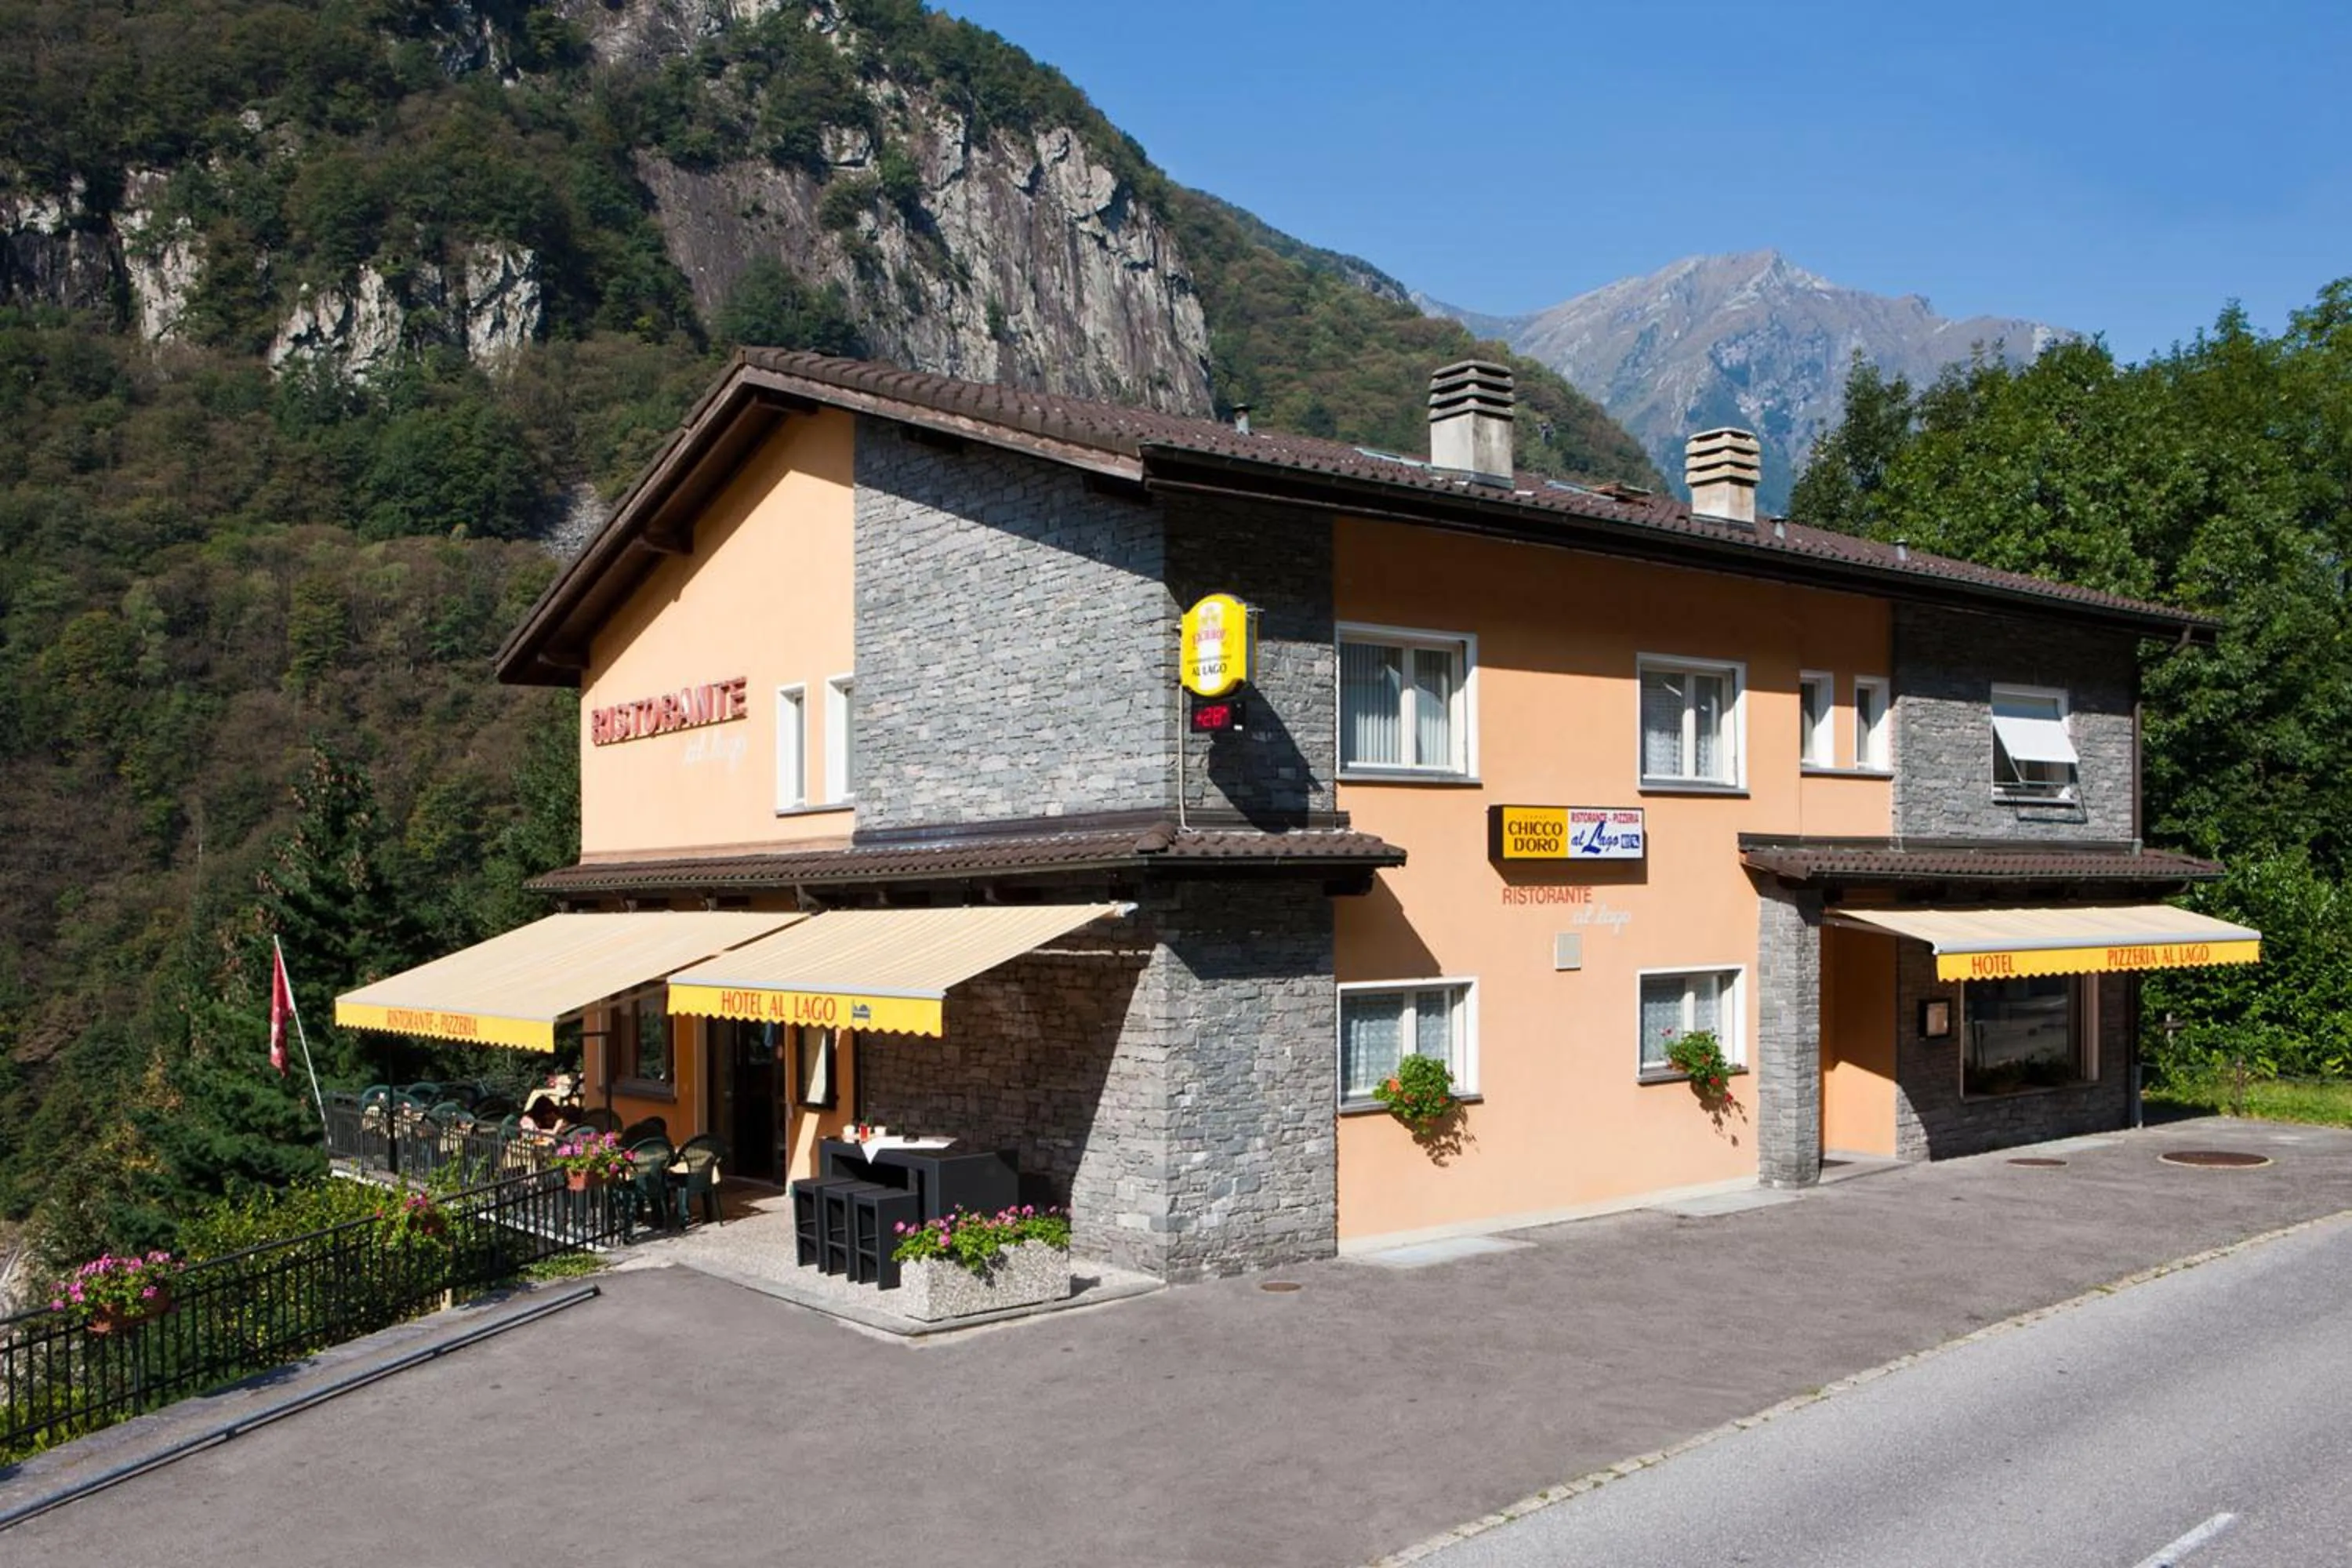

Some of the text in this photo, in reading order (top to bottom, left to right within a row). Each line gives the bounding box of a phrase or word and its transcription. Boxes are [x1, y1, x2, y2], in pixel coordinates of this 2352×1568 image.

[591, 676, 747, 746] RISTORANTE
[1508, 820, 1563, 837] CHICCO
[1570, 812, 1607, 822] RISTORANTE
[1613, 813, 1639, 823] PIZZERIA
[1570, 821, 1619, 853] al Lago
[1502, 887, 1593, 905] RISTORANTE
[1971, 944, 2209, 976] HOTEL PIZZERIA AL LAGO
[721, 990, 837, 1022] HOTEL AL LAGO
[387, 1008, 434, 1032] RISTORANTE
[440, 1013, 477, 1037] PIZZERIA
